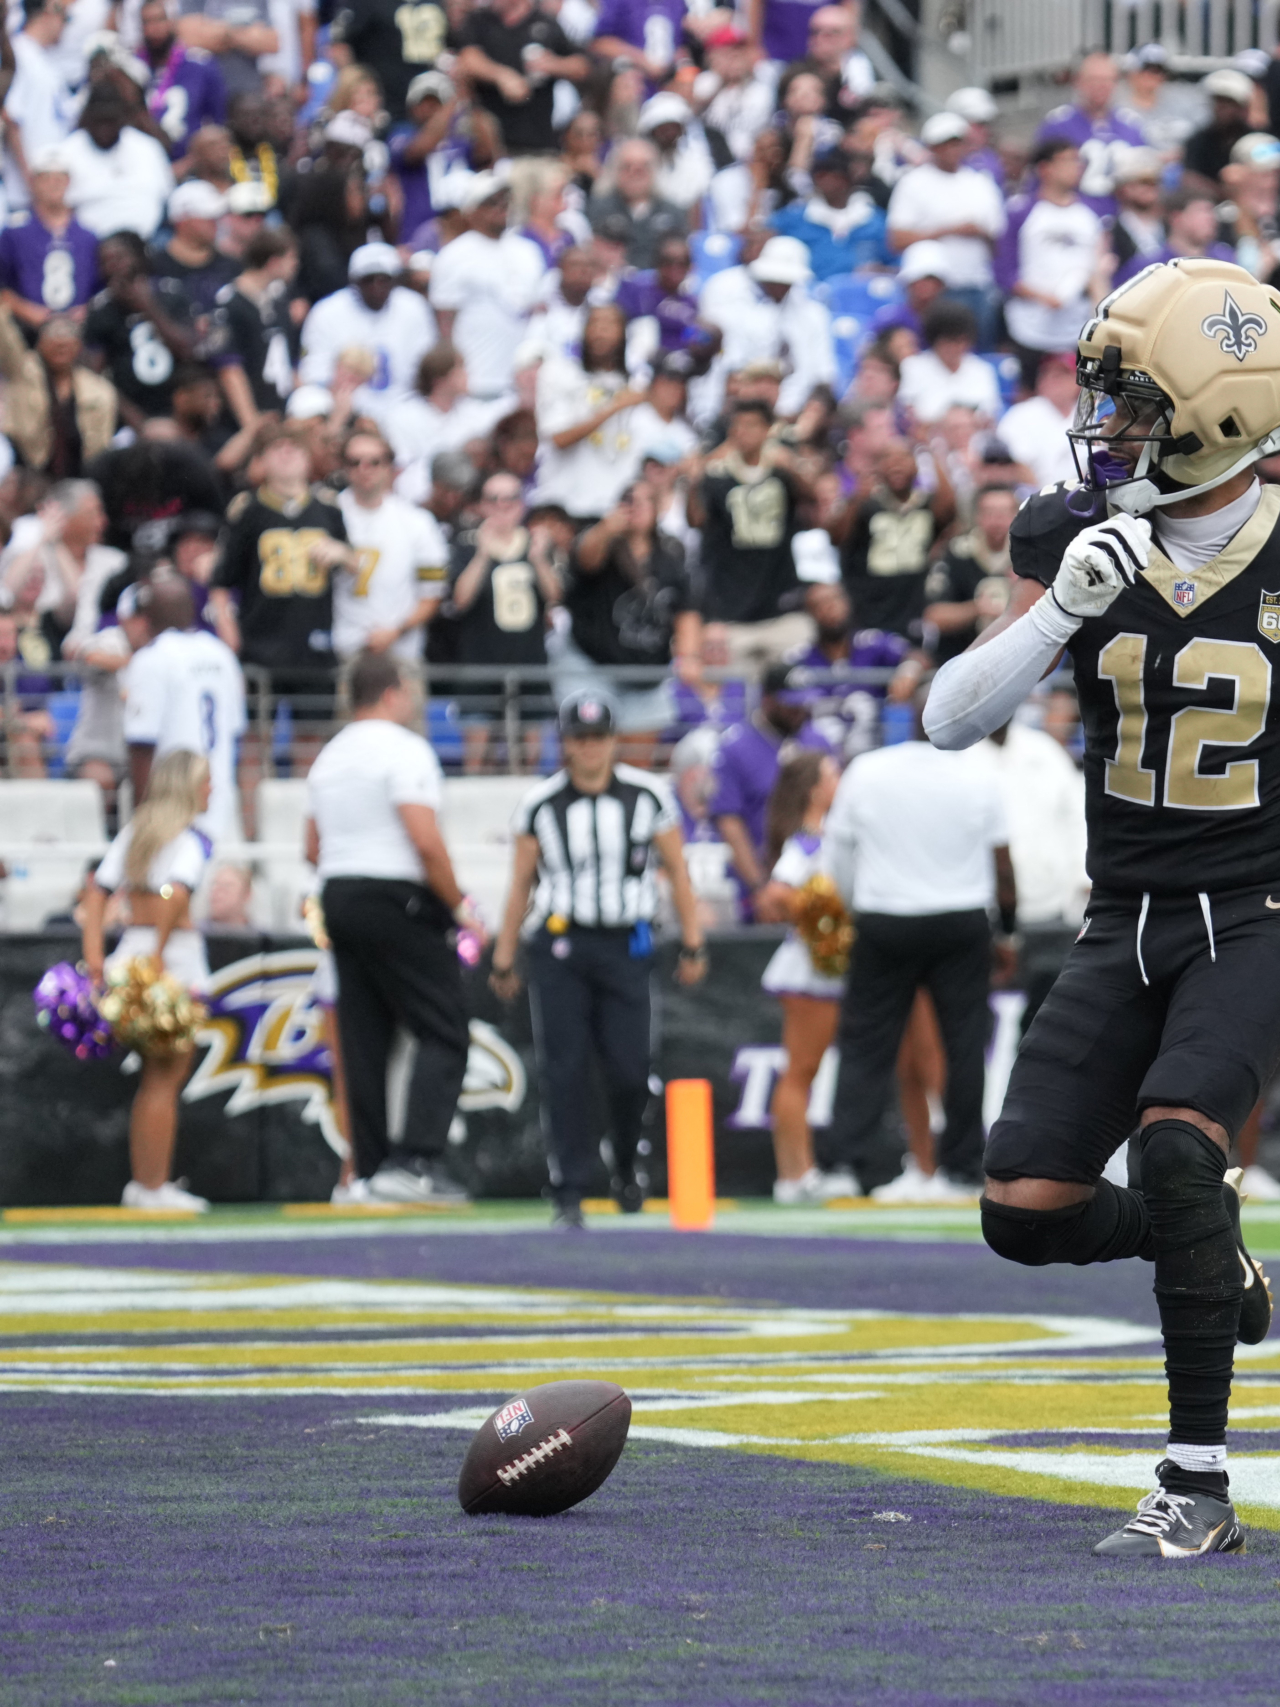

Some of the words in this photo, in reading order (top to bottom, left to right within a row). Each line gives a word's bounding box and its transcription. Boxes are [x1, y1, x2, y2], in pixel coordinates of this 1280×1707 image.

[42, 249, 75, 310] 8
[725, 477, 786, 549] 12
[491, 562, 538, 633] 6
[1176, 591, 1192, 603] NFL
[1265, 596, 1278, 604] EST.
[1097, 631, 1272, 811] 12
[496, 1401, 525, 1425] NFL
